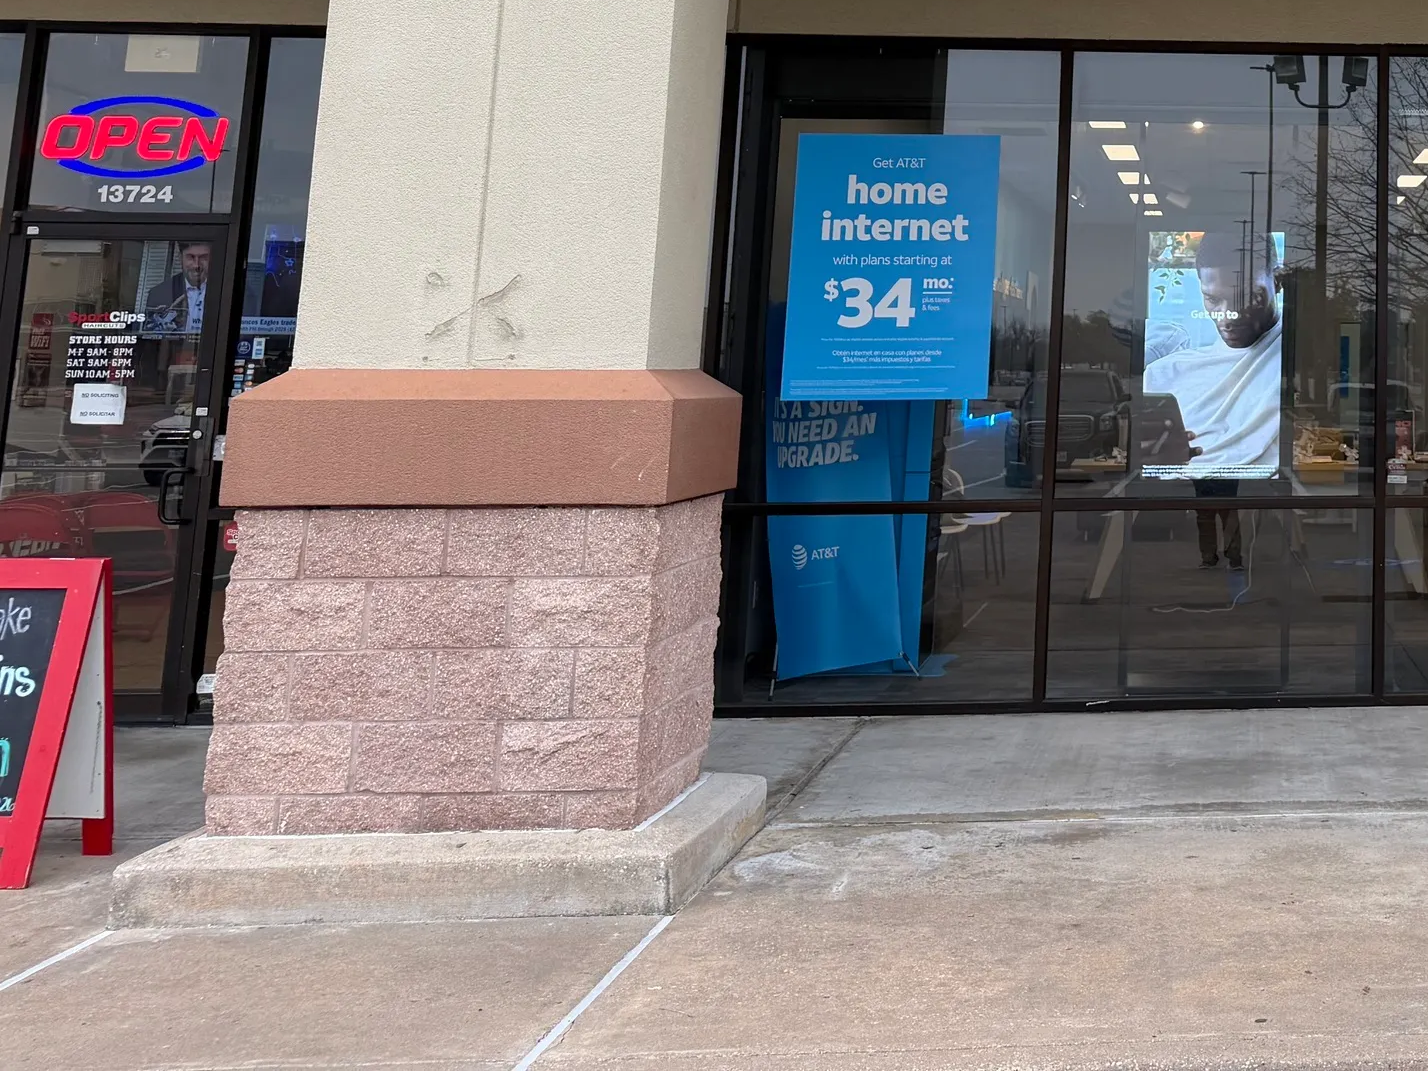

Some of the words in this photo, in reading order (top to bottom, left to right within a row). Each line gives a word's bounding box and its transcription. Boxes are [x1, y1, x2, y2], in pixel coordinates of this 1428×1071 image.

[40, 114, 229, 161] OPEN
[872, 157, 894, 169] Get
[896, 157, 926, 169] AT&T
[98, 185, 173, 204] 13724
[847, 175, 948, 205] home
[821, 210, 969, 241] internet
[833, 254, 858, 266] with
[860, 254, 891, 268] plans
[893, 254, 938, 268] starting
[940, 255, 953, 266] at
[823, 276, 916, 329] $34
[68, 311, 146, 326] SportClips
[1190, 309, 1209, 319] Get
[1211, 311, 1226, 322] up
[1226, 309, 1239, 320] to
[69, 335, 102, 345] STORE
[104, 335, 138, 344] HOURS
[68, 348, 84, 356] M-F
[86, 348, 107, 356] 9AM
[113, 348, 133, 356] 8PM
[66, 359, 86, 367] SAT
[65, 370, 84, 378] SUN
[790, 401, 802, 419] A
[788, 418, 838, 444] NEED
[841, 412, 878, 438] AN
[778, 439, 860, 469] UPGRADE.
[811, 546, 840, 561] AT&T
